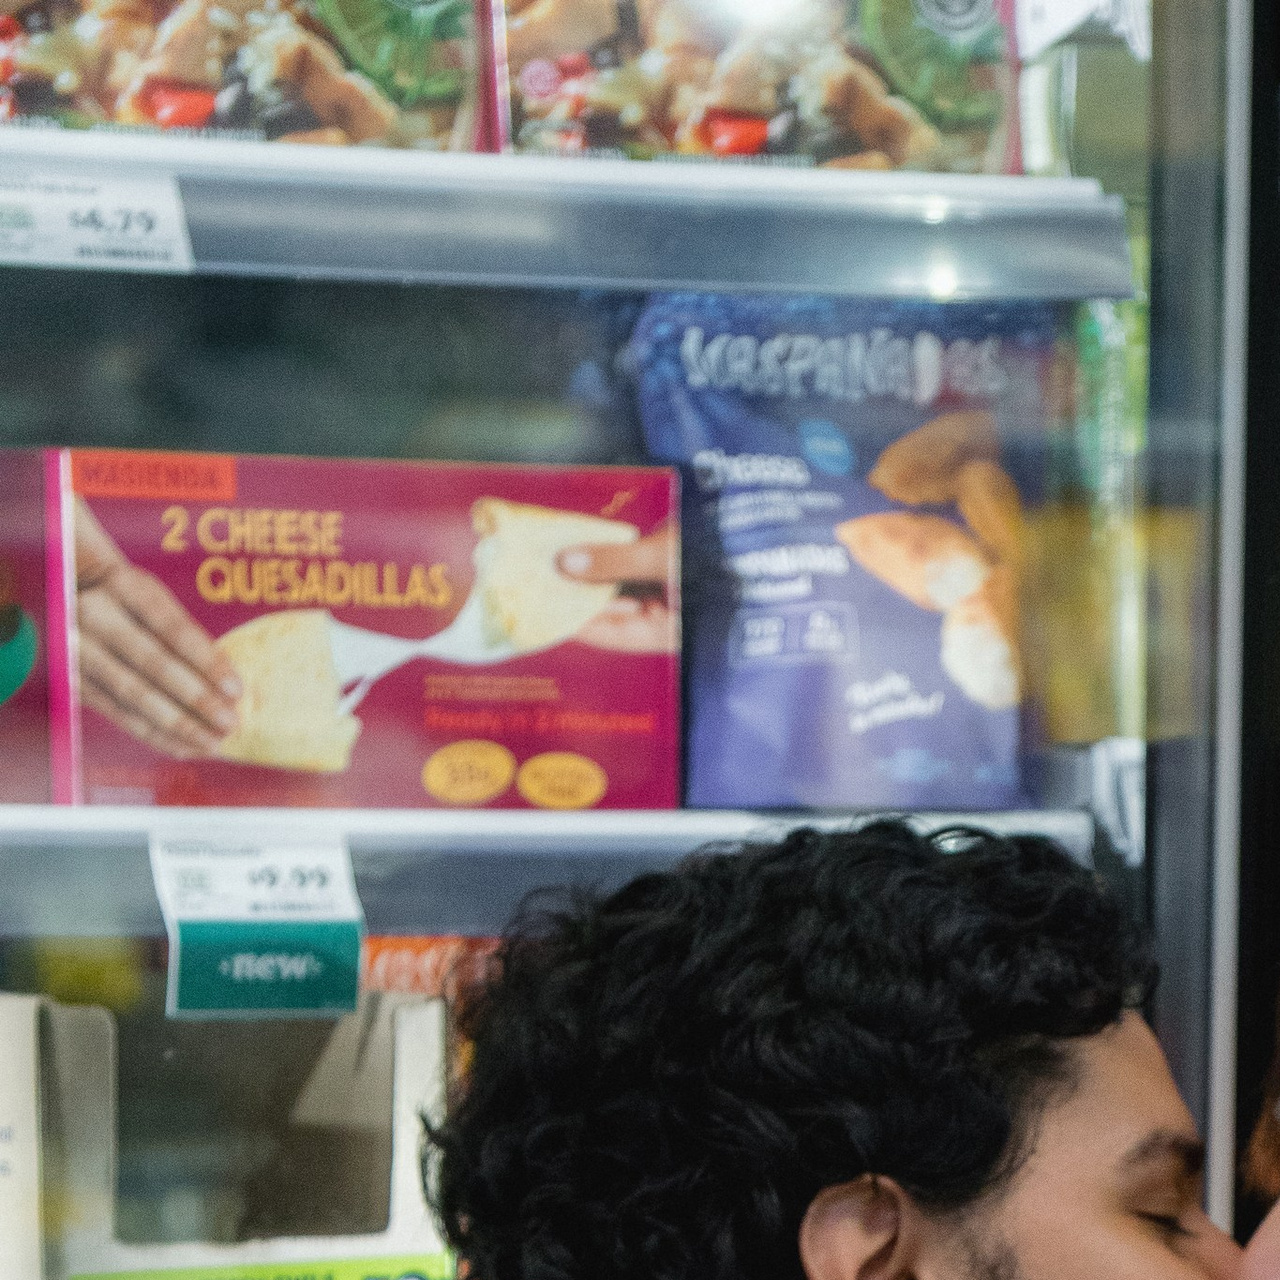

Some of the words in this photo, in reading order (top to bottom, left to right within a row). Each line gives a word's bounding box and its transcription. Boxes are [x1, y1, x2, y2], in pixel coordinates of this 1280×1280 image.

[160, 506, 188, 553] 2
[197, 508, 344, 557] CHEESE
[196, 558, 453, 606] QUESADILLAS
